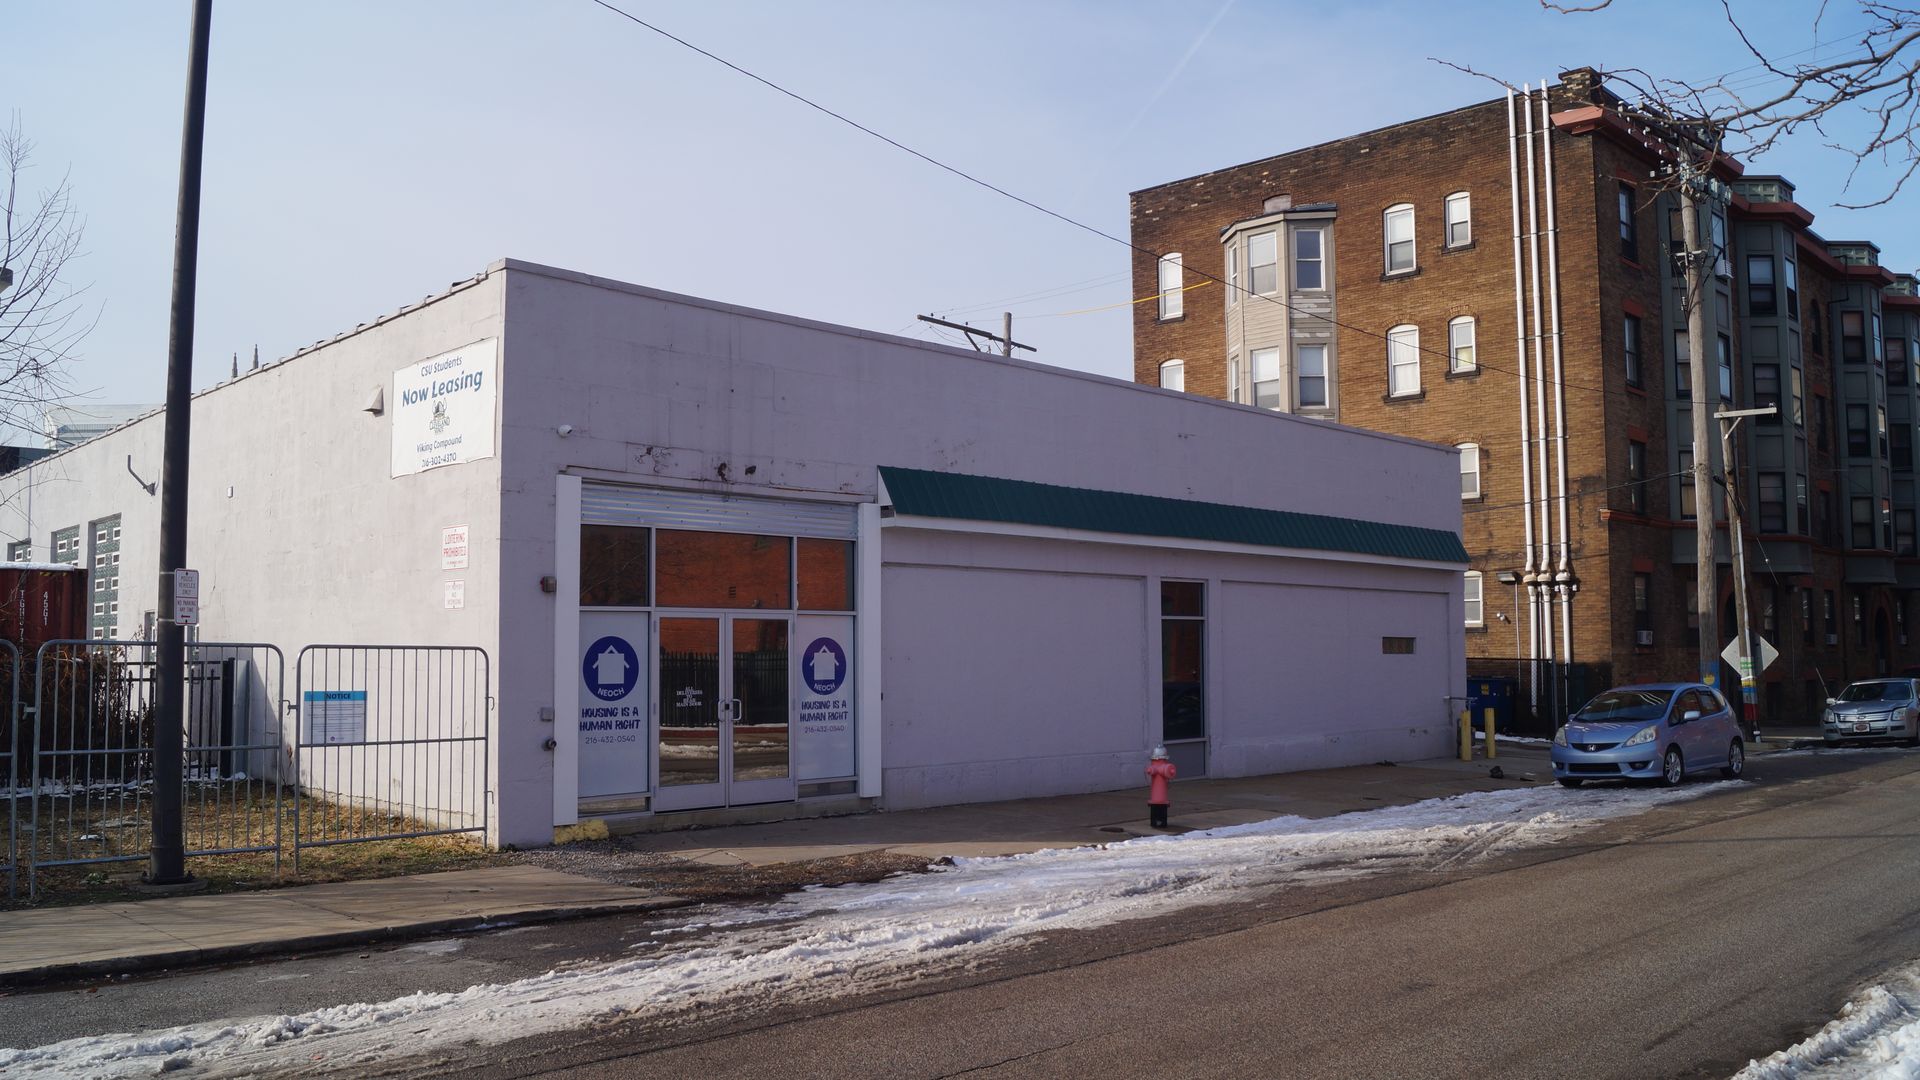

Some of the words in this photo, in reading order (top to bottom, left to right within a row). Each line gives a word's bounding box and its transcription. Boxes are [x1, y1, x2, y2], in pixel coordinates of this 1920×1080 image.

[420, 364, 433, 377] CSU
[434, 356, 463, 373] Students
[402, 386, 429, 407] Now
[431, 369, 483, 399] Leasing
[416, 442, 433, 453] Viking
[433, 434, 463, 447] Compound
[597, 687, 625, 697] NEOCH
[813, 682, 836, 692] NEOCH
[801, 700, 831, 711] HOUSING
[832, 700, 840, 709] IS
[841, 699, 847, 709] A
[581, 707, 619, 718] HOUSING
[621, 707, 630, 717] IS
[632, 706, 639, 717] A
[799, 713, 827, 722] HUMAN
[827, 711, 849, 721] RIGHT
[579, 721, 613, 732] HUMAN
[615, 719, 641, 730] RIGHT
[804, 725, 844, 733] 216-432-0540
[585, 735, 636, 745] 216-432-0540
